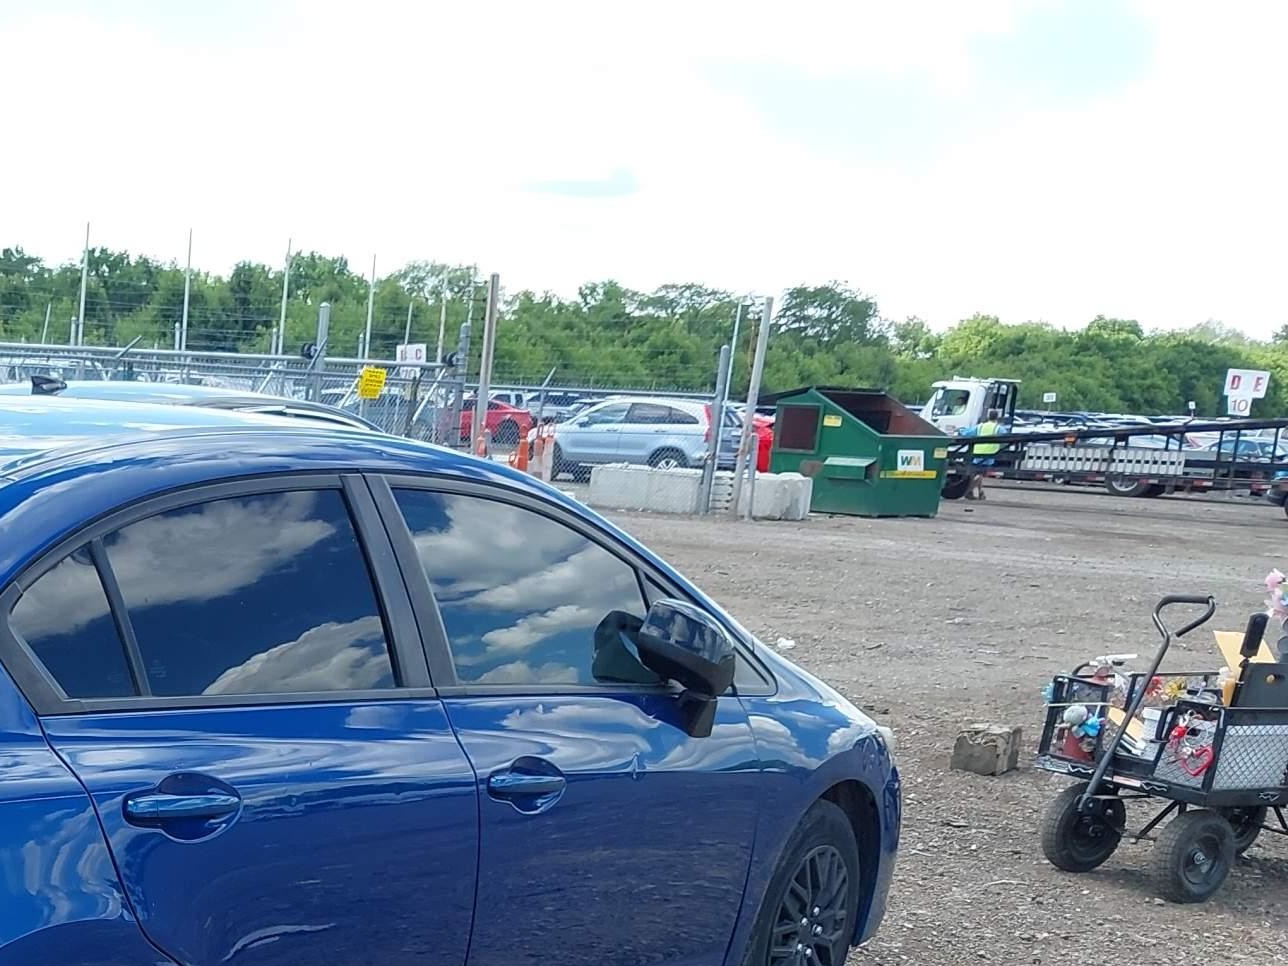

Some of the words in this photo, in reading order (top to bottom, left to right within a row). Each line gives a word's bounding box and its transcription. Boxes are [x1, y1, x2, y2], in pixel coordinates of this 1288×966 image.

[415, 348, 422, 361] C
[1230, 375, 1241, 390] D
[1253, 376, 1264, 392] E
[1232, 399, 1248, 412] 10
[900, 455, 921, 466] WM
